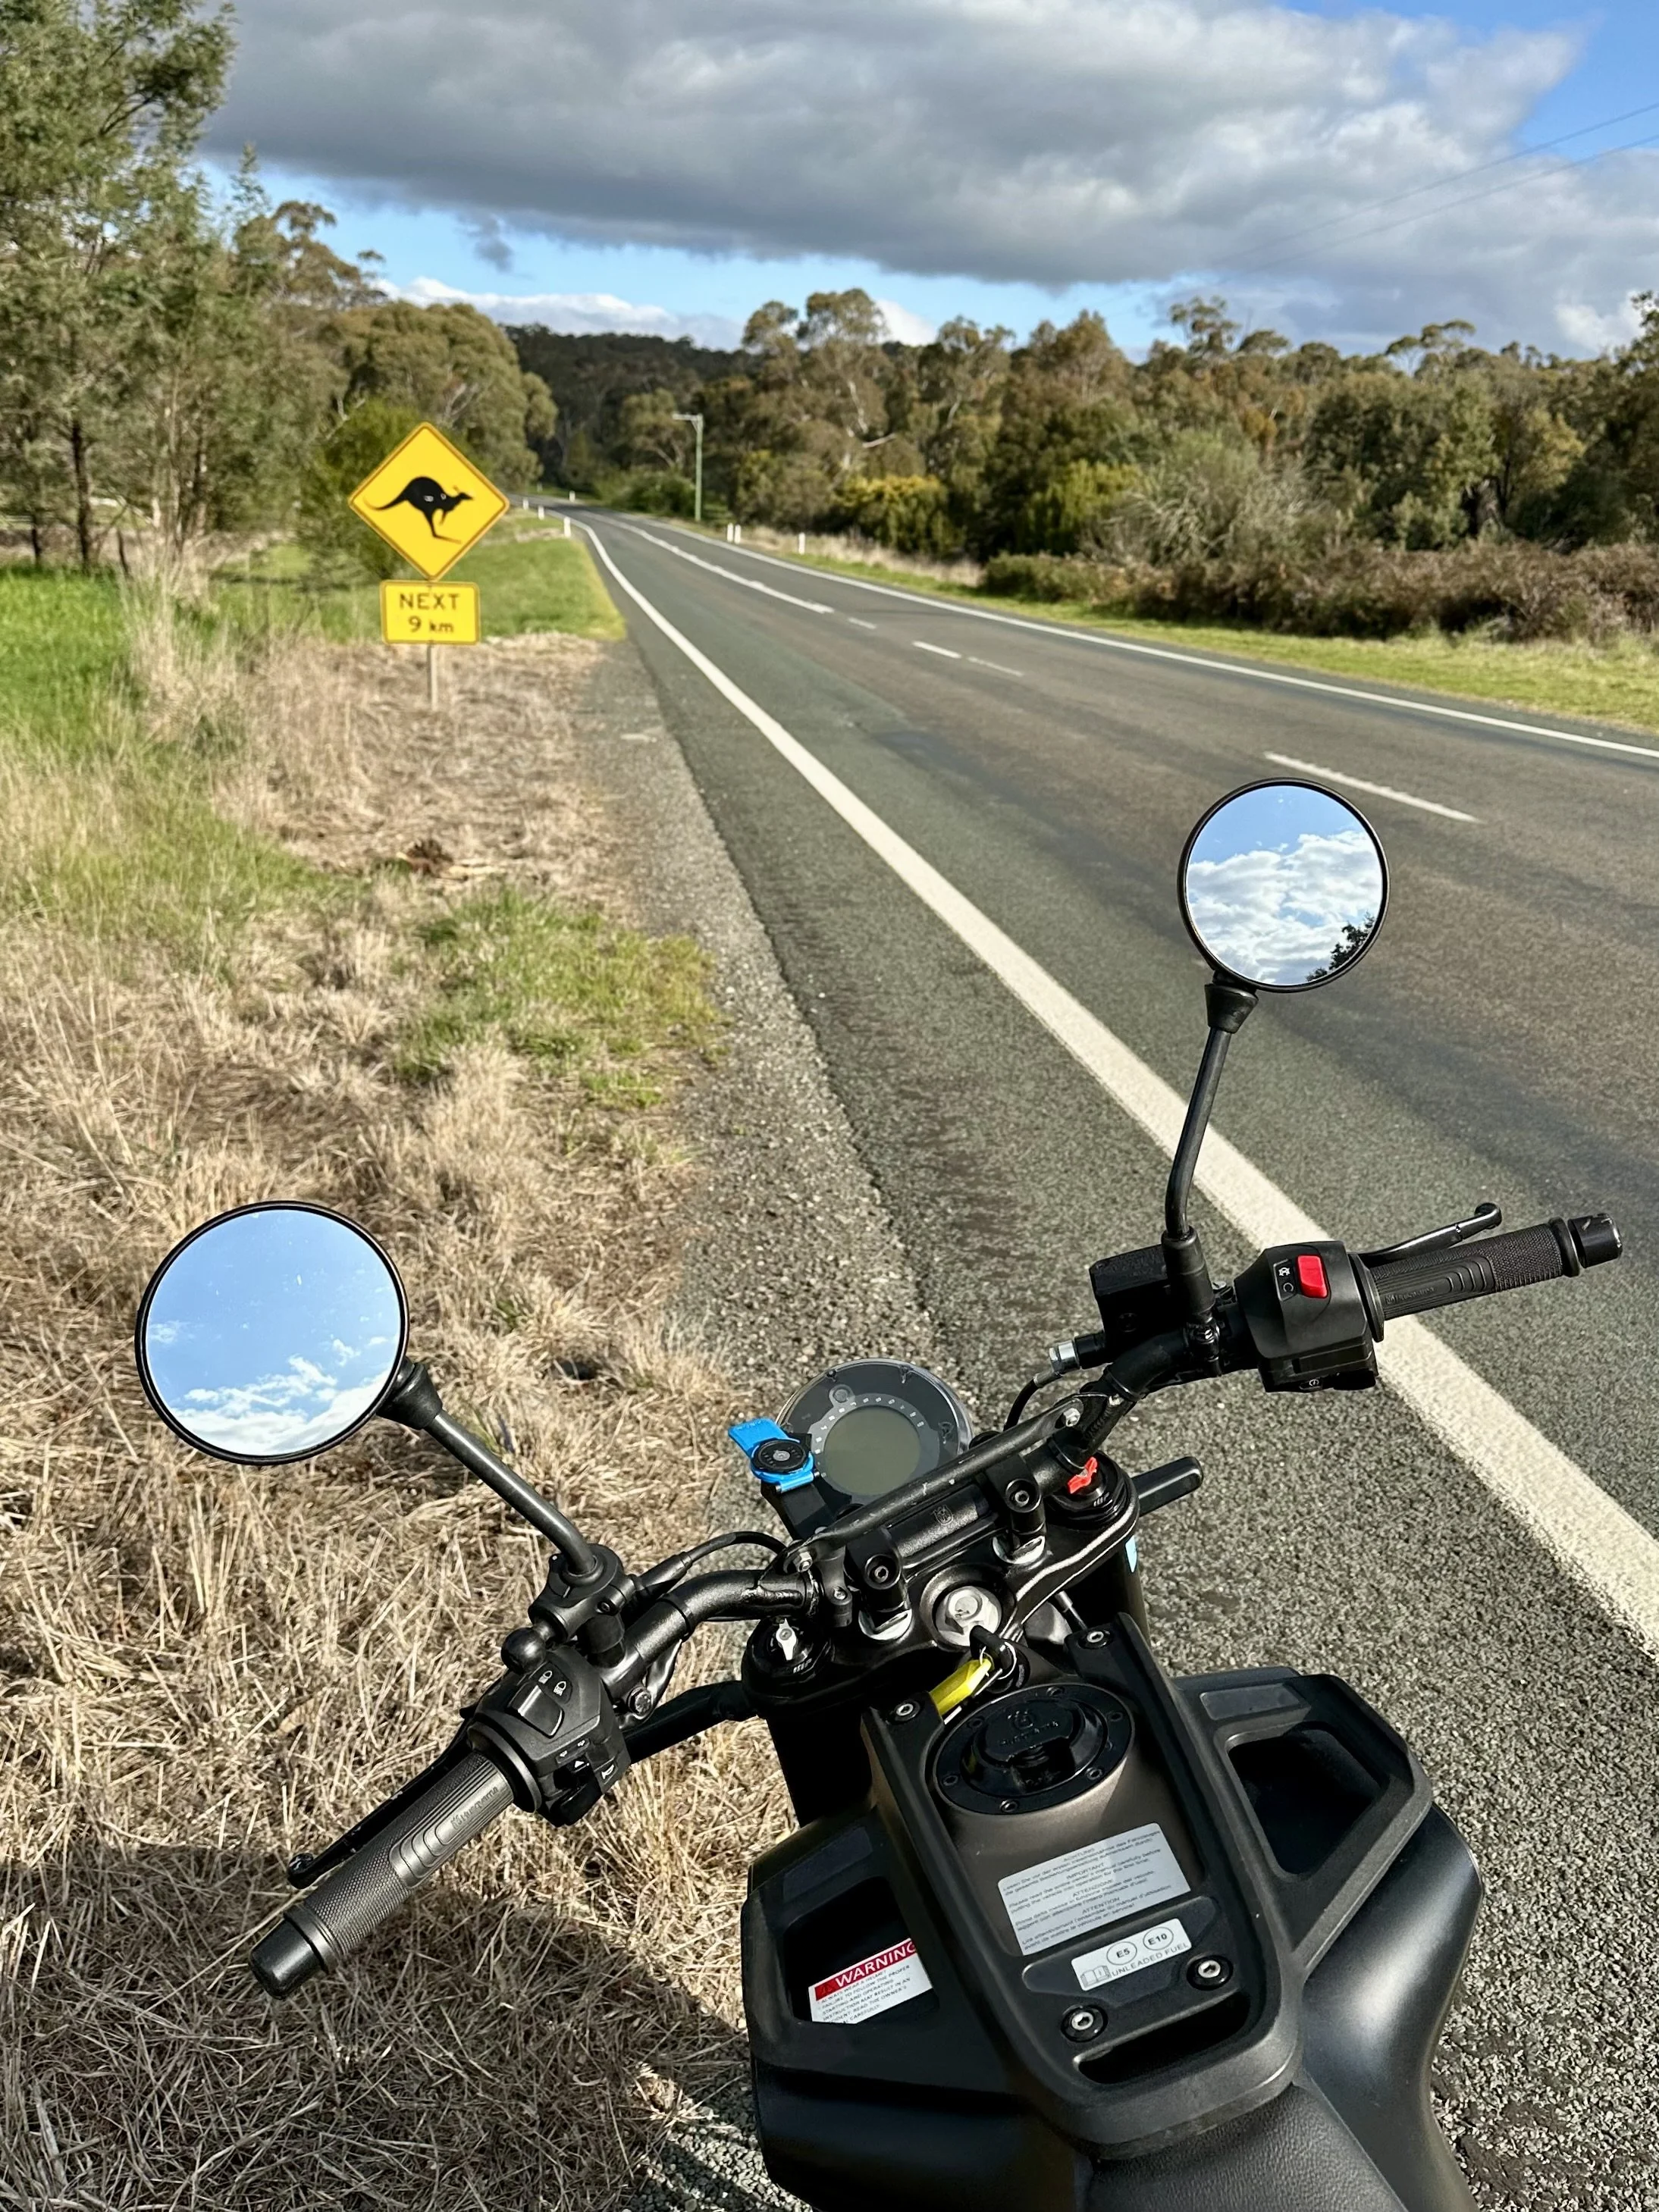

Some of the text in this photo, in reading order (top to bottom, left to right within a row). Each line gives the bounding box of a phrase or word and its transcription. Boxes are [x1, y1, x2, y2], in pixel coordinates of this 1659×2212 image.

[399, 593, 460, 610] NEXT
[408, 615, 454, 633] 9 km
[1081, 1896, 1120, 1914] ATTENTION
[1147, 1932, 1168, 1945] E10
[1111, 1941, 1188, 1977] UNLEADED FUEL
[1115, 1947, 1131, 1958] E5
